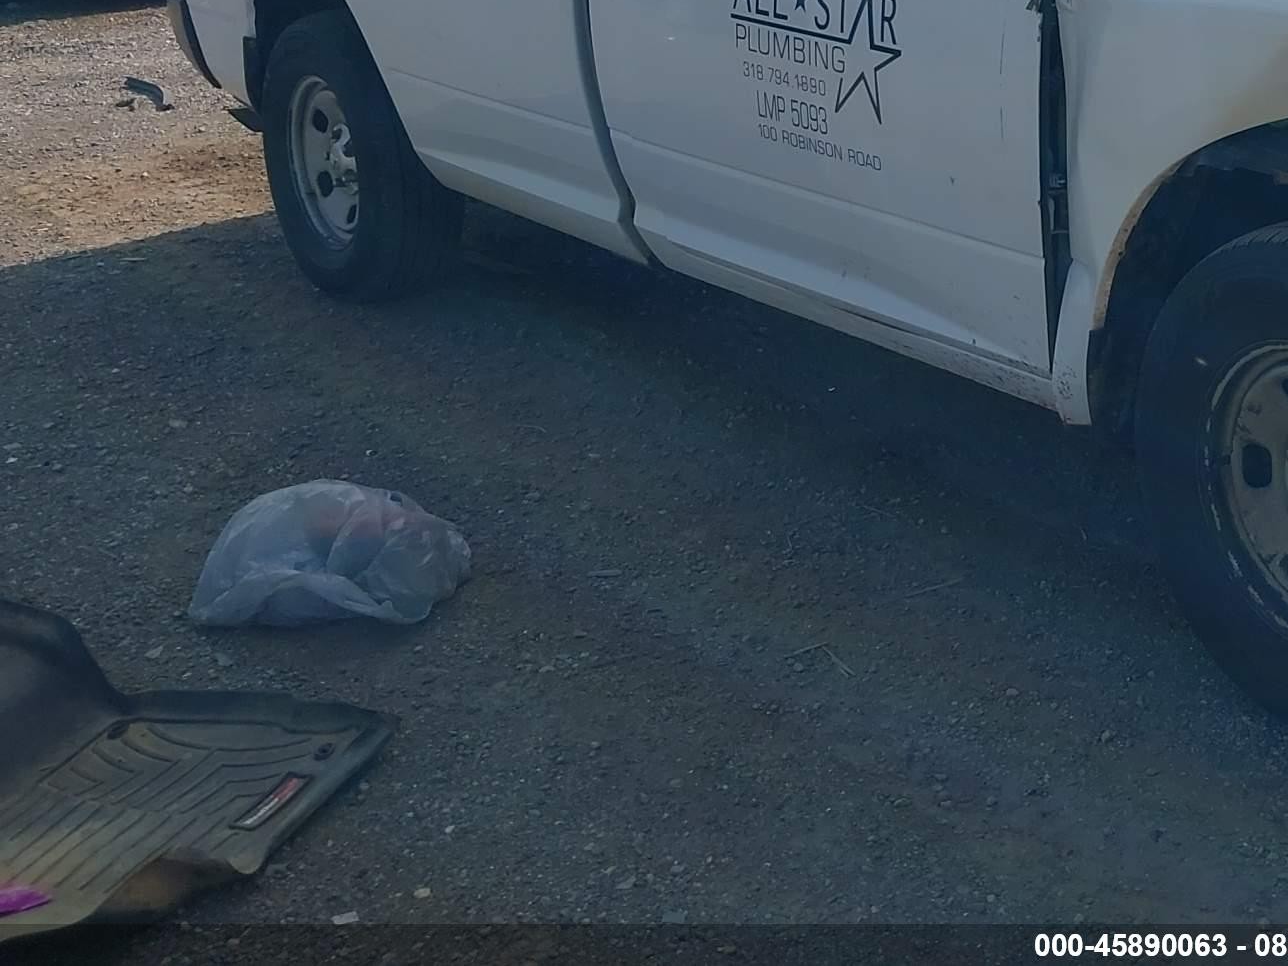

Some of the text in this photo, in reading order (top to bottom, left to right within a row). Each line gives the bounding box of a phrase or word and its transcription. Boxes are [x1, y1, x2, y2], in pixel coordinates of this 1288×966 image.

[735, 22, 846, 74] PLUMBING
[756, 89, 829, 135] LMP 5093
[758, 123, 882, 171] 100 ROBINSON ROAD
